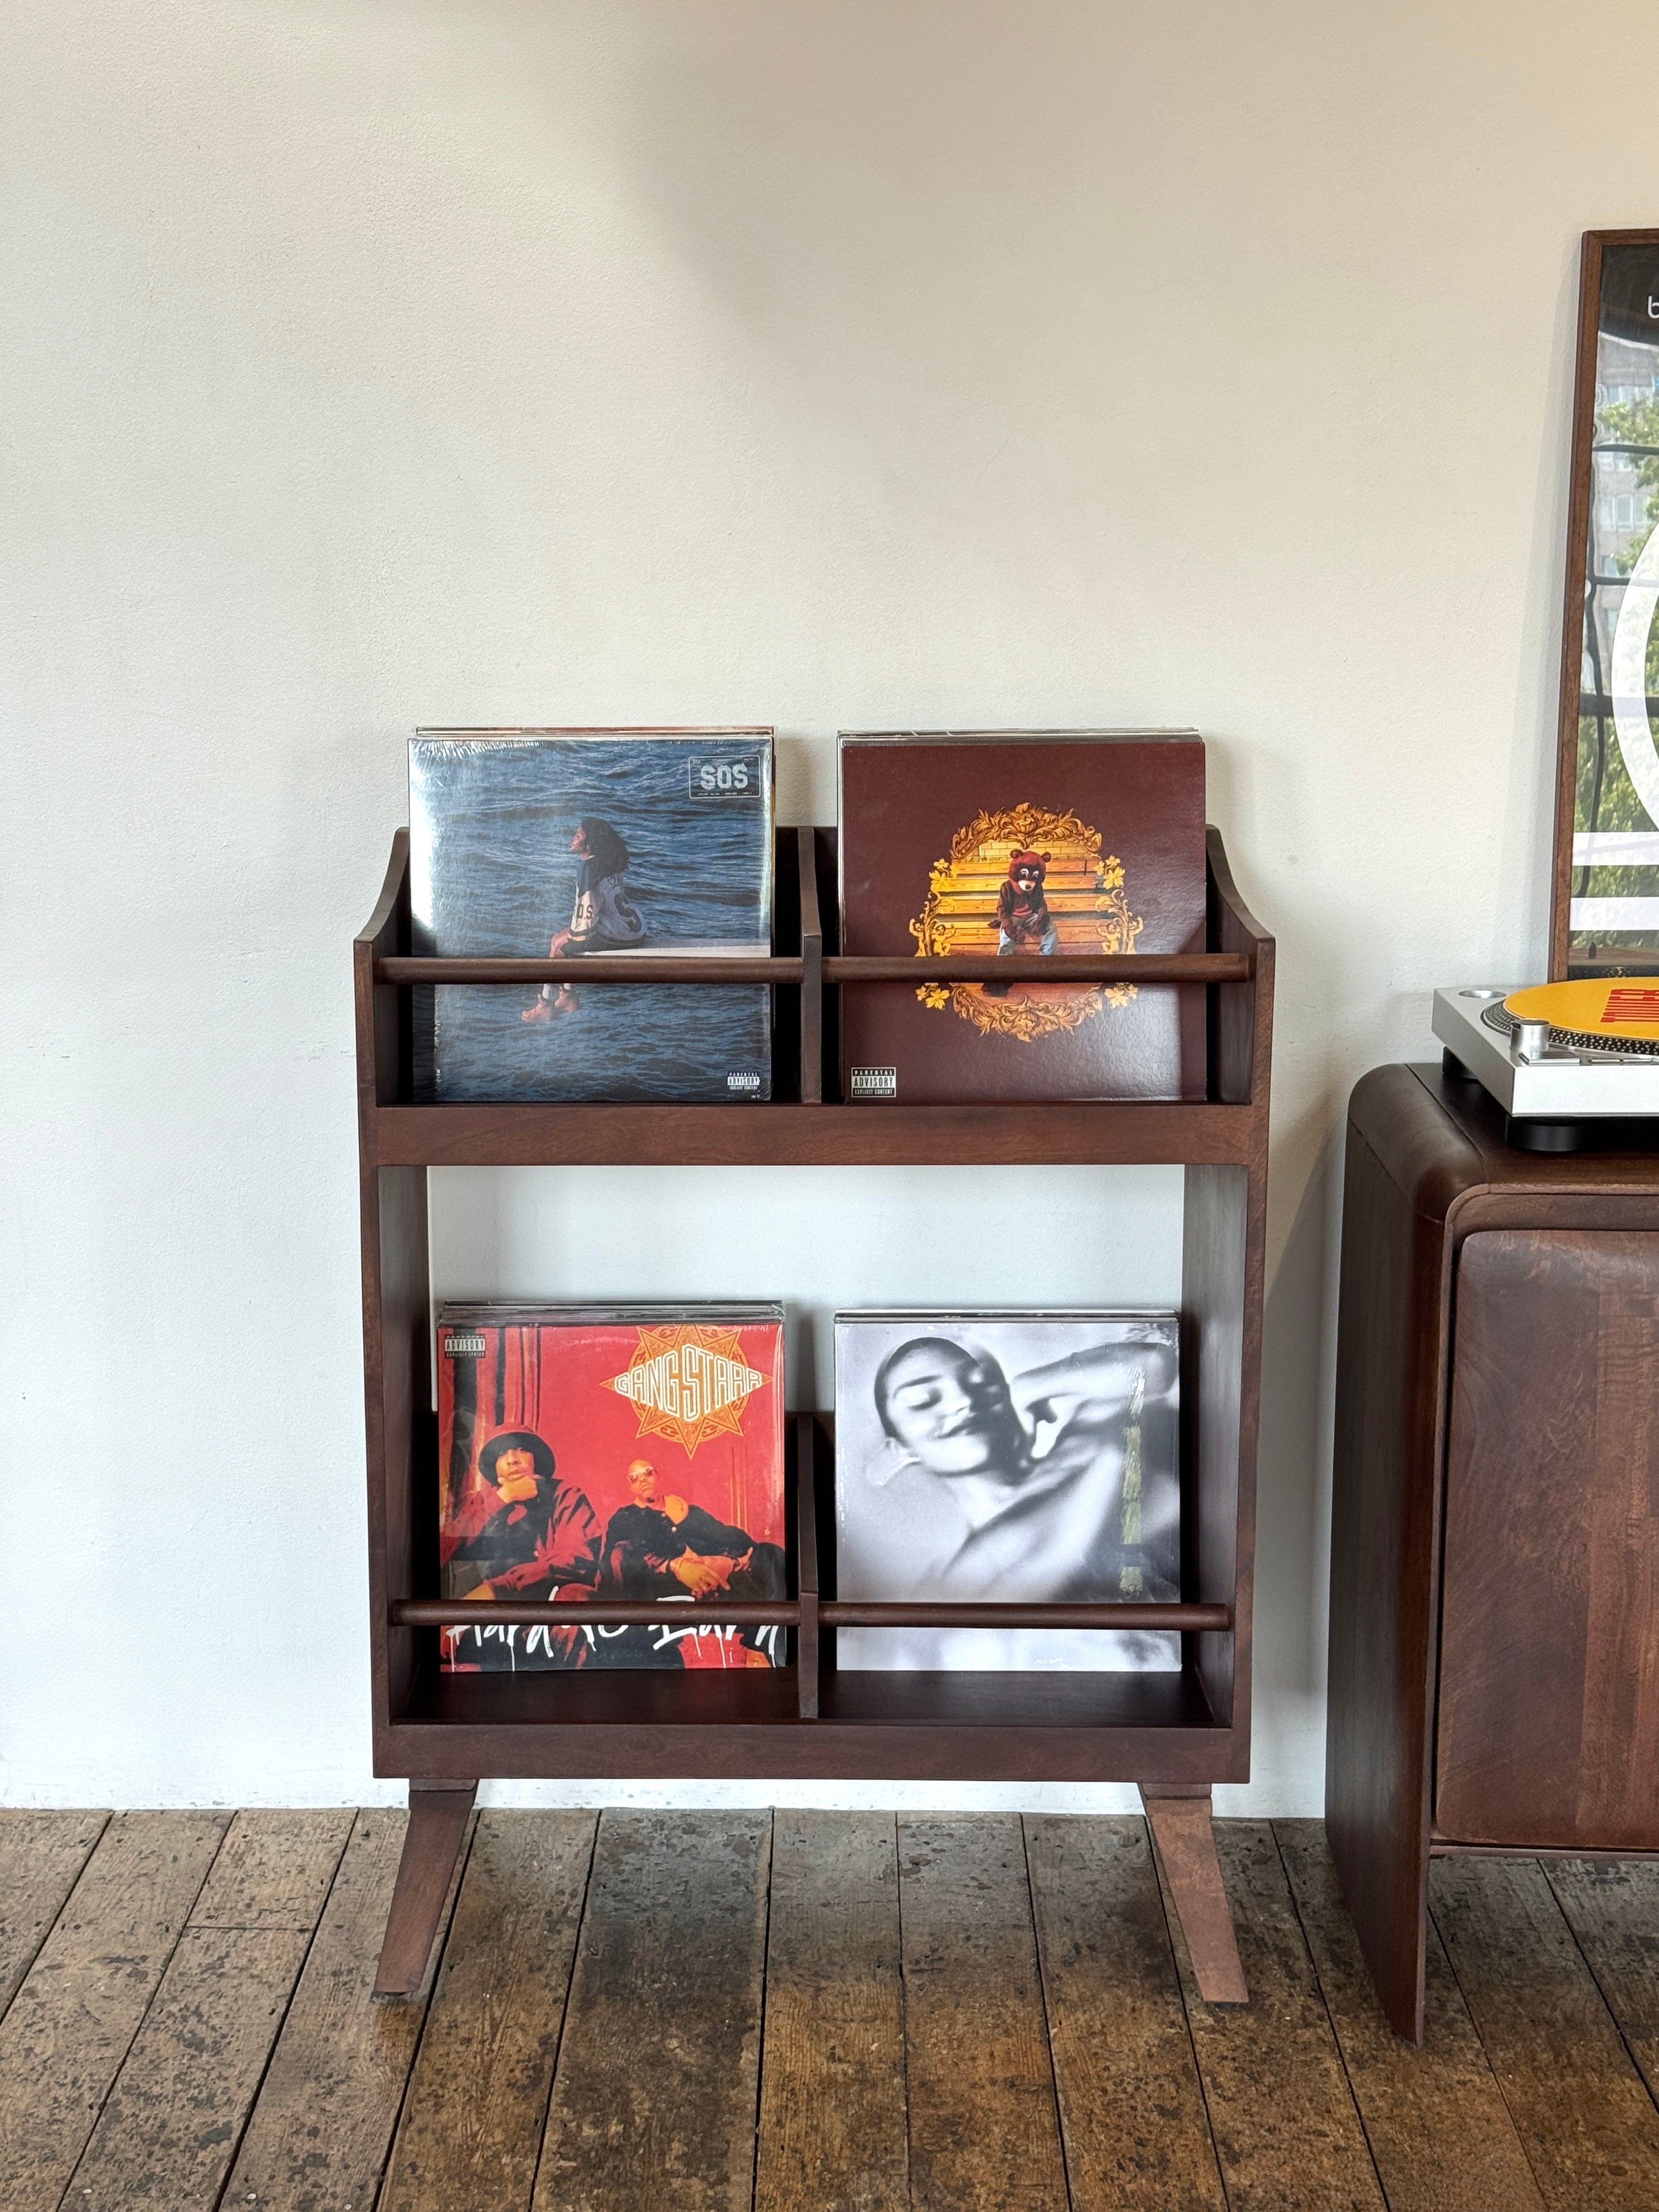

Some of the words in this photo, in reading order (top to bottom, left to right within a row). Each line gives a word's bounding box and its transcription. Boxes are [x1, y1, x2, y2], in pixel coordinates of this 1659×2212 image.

[700, 763, 748, 790] SOS
[854, 1077, 893, 1086] ADVISORY
[447, 1339, 484, 1350] ADVISORY
